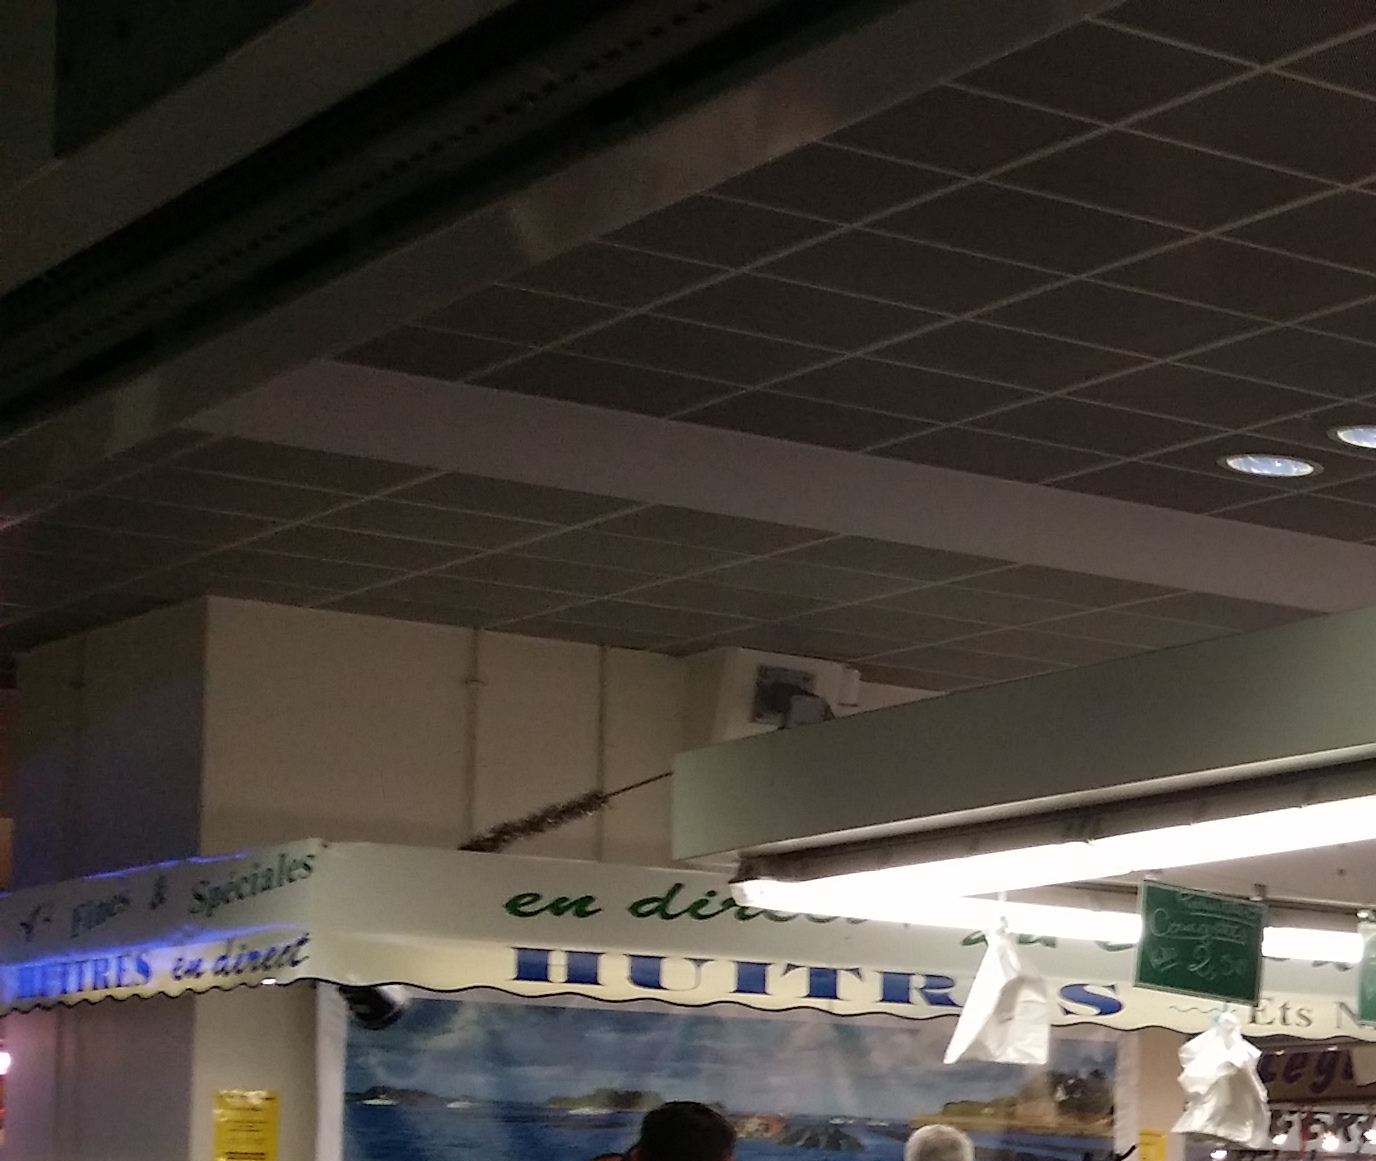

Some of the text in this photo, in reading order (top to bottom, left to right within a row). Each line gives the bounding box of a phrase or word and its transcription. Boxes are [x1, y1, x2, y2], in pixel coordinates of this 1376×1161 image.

[505, 882, 868, 924] en dir
[512, 946, 1124, 1017] HUITRS
